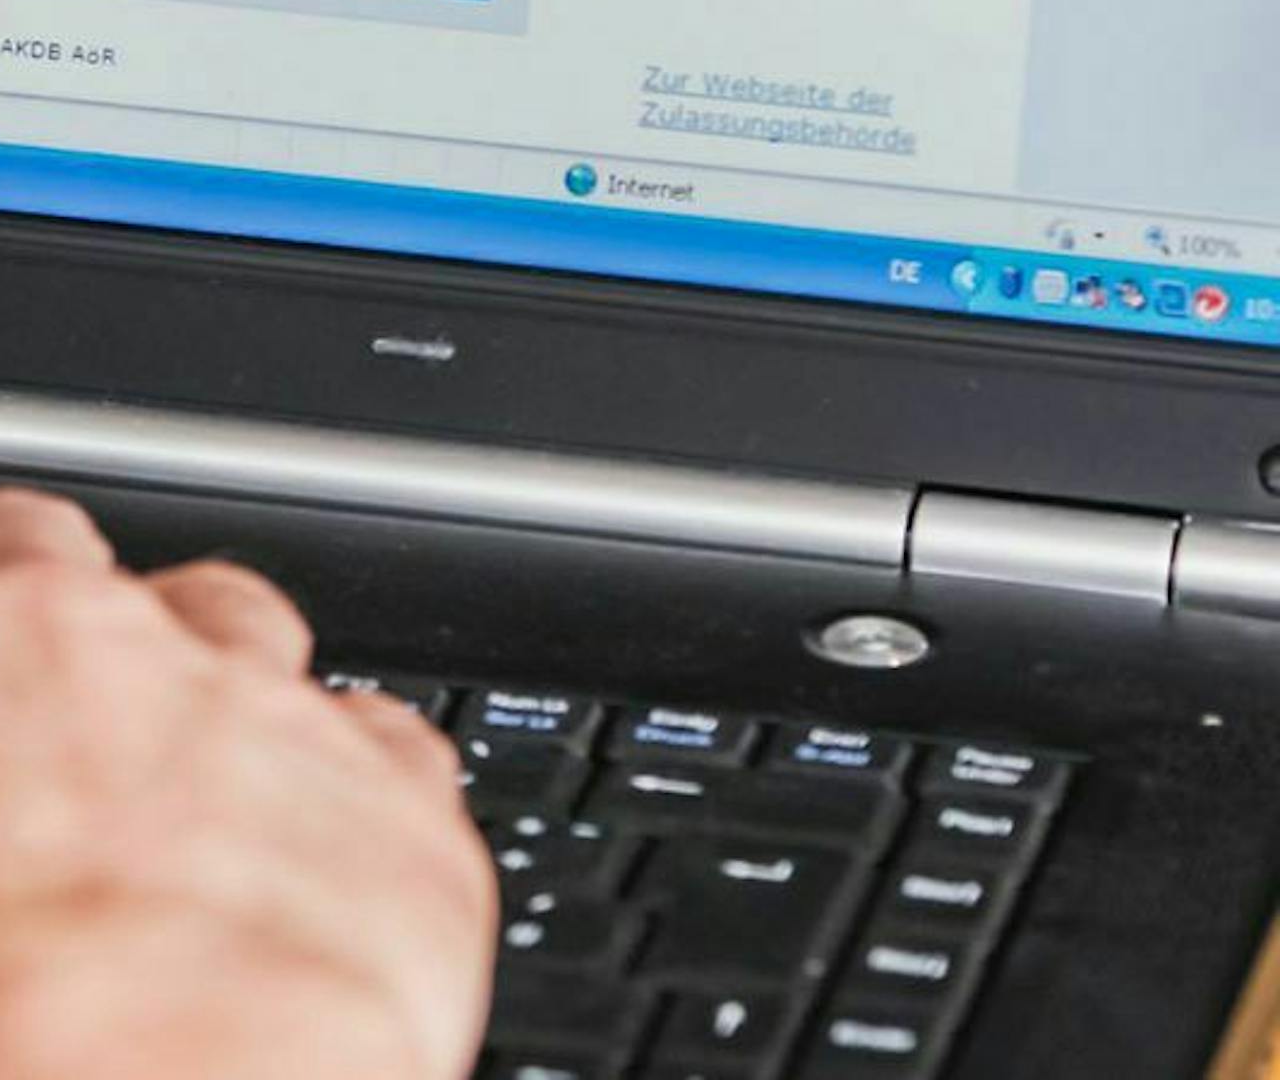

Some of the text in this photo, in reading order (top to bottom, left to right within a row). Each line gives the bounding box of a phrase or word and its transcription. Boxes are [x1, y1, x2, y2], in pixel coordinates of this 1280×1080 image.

[0, 39, 63, 63] AKDB
[641, 63, 896, 117] Zur Webseite der
[606, 174, 695, 204] Internet
[888, 258, 922, 286] DE
